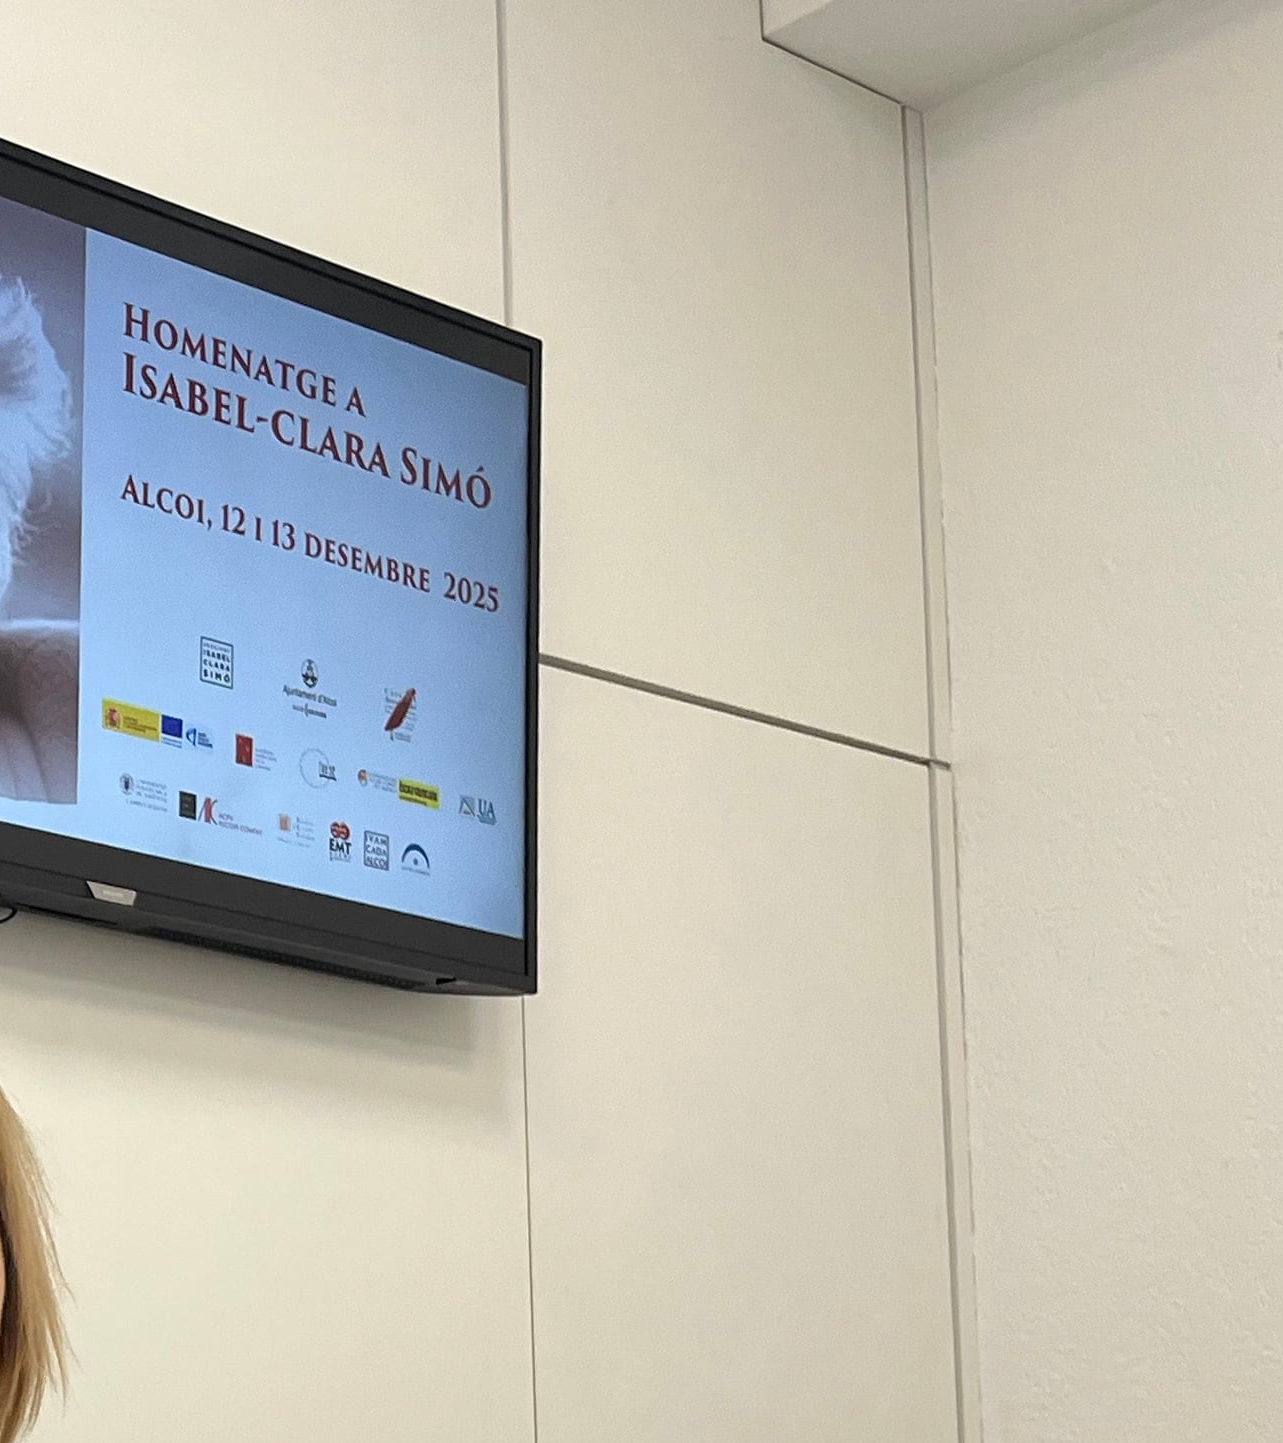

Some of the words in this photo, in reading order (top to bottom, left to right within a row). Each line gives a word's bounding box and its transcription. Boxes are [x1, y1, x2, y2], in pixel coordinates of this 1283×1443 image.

[122, 302, 337, 407] HOMENATGE
[346, 386, 367, 417] A
[122, 352, 391, 478] ISABEL-CLARA
[400, 447, 493, 509] SIMÓ
[120, 474, 214, 531] ALCOI,
[220, 504, 246, 536] 12
[272, 519, 296, 551] 13
[304, 533, 431, 593] DESEMBRE
[443, 572, 500, 613] 2025
[202, 658, 231, 672] CLARA
[329, 838, 352, 855] EMT
